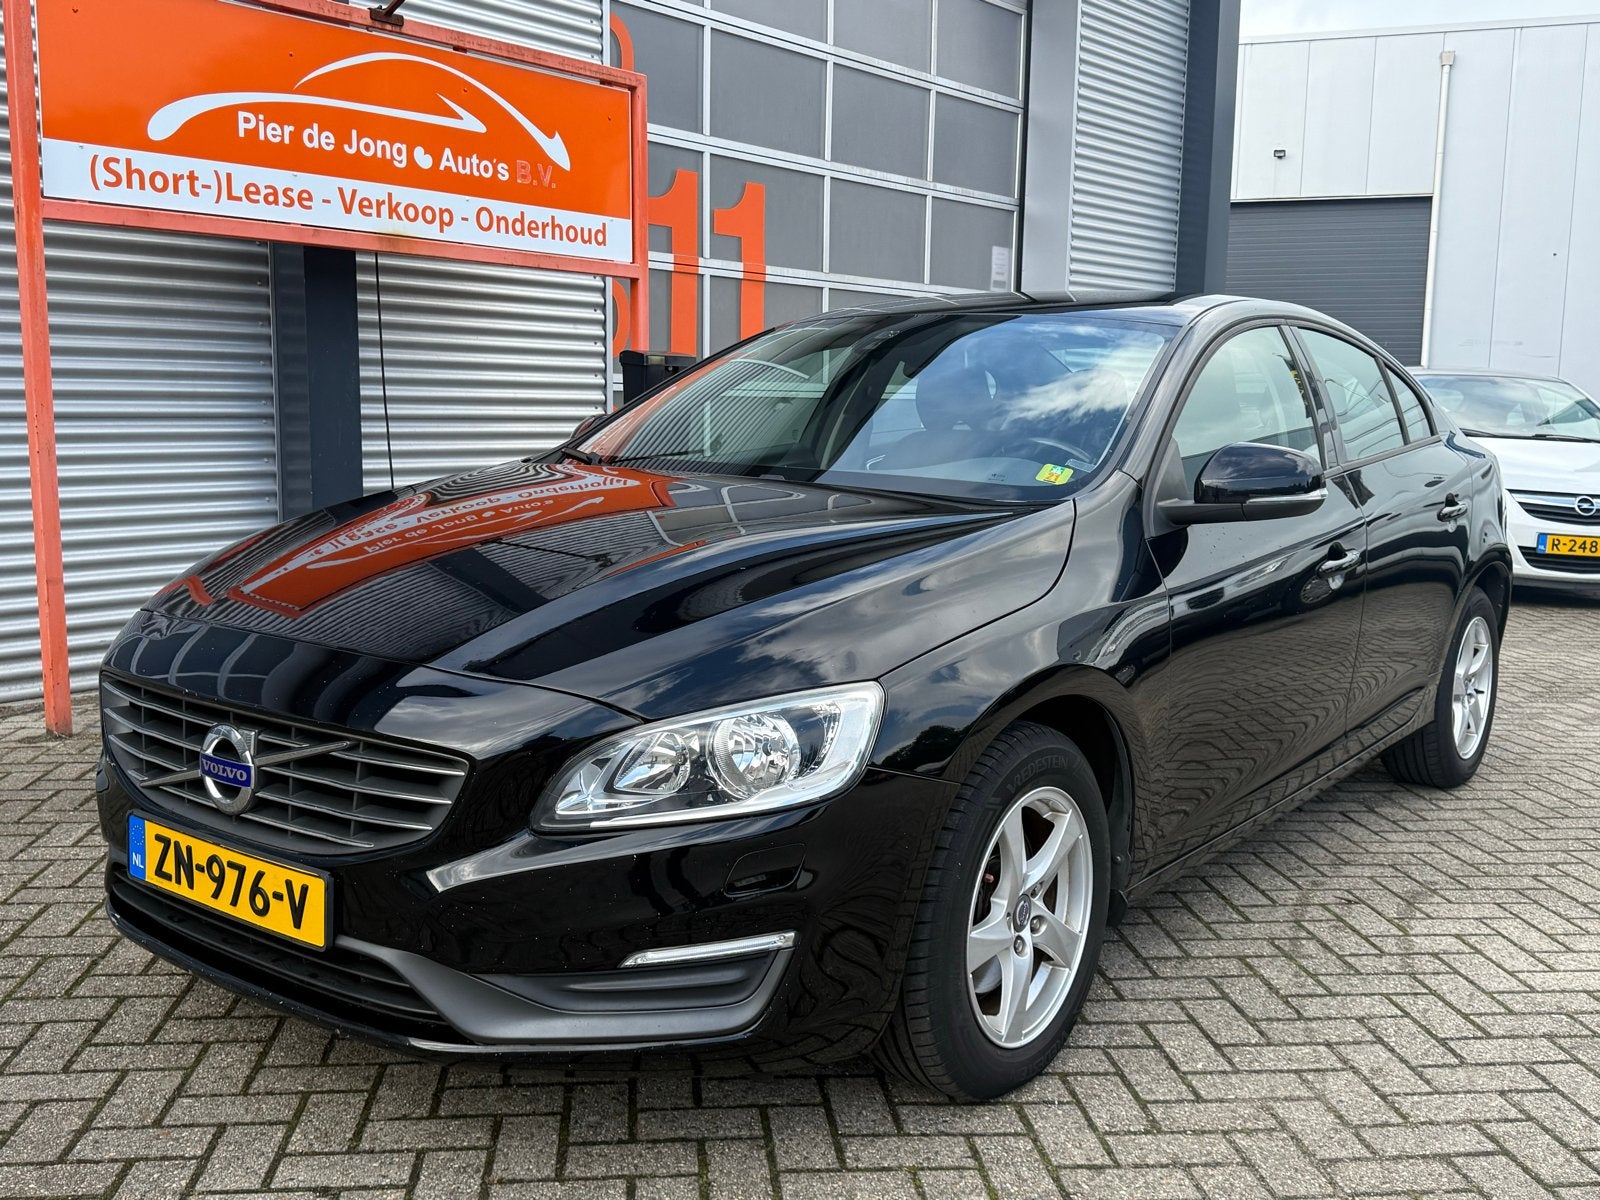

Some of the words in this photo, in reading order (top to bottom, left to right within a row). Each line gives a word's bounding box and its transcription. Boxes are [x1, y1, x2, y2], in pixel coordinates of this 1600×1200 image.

[237, 110, 295, 144] Pier
[302, 122, 335, 151] de
[343, 129, 407, 168] Jong
[439, 147, 510, 181] Auto's
[516, 159, 557, 189] B.V.
[90, 154, 313, 210] (Short-)Lease
[337, 186, 454, 233] Verkoop
[475, 206, 608, 247] Onderhoud
[201, 758, 248, 782] VOLVO
[132, 852, 144, 870] NL
[154, 833, 309, 930] ZN-976-V
